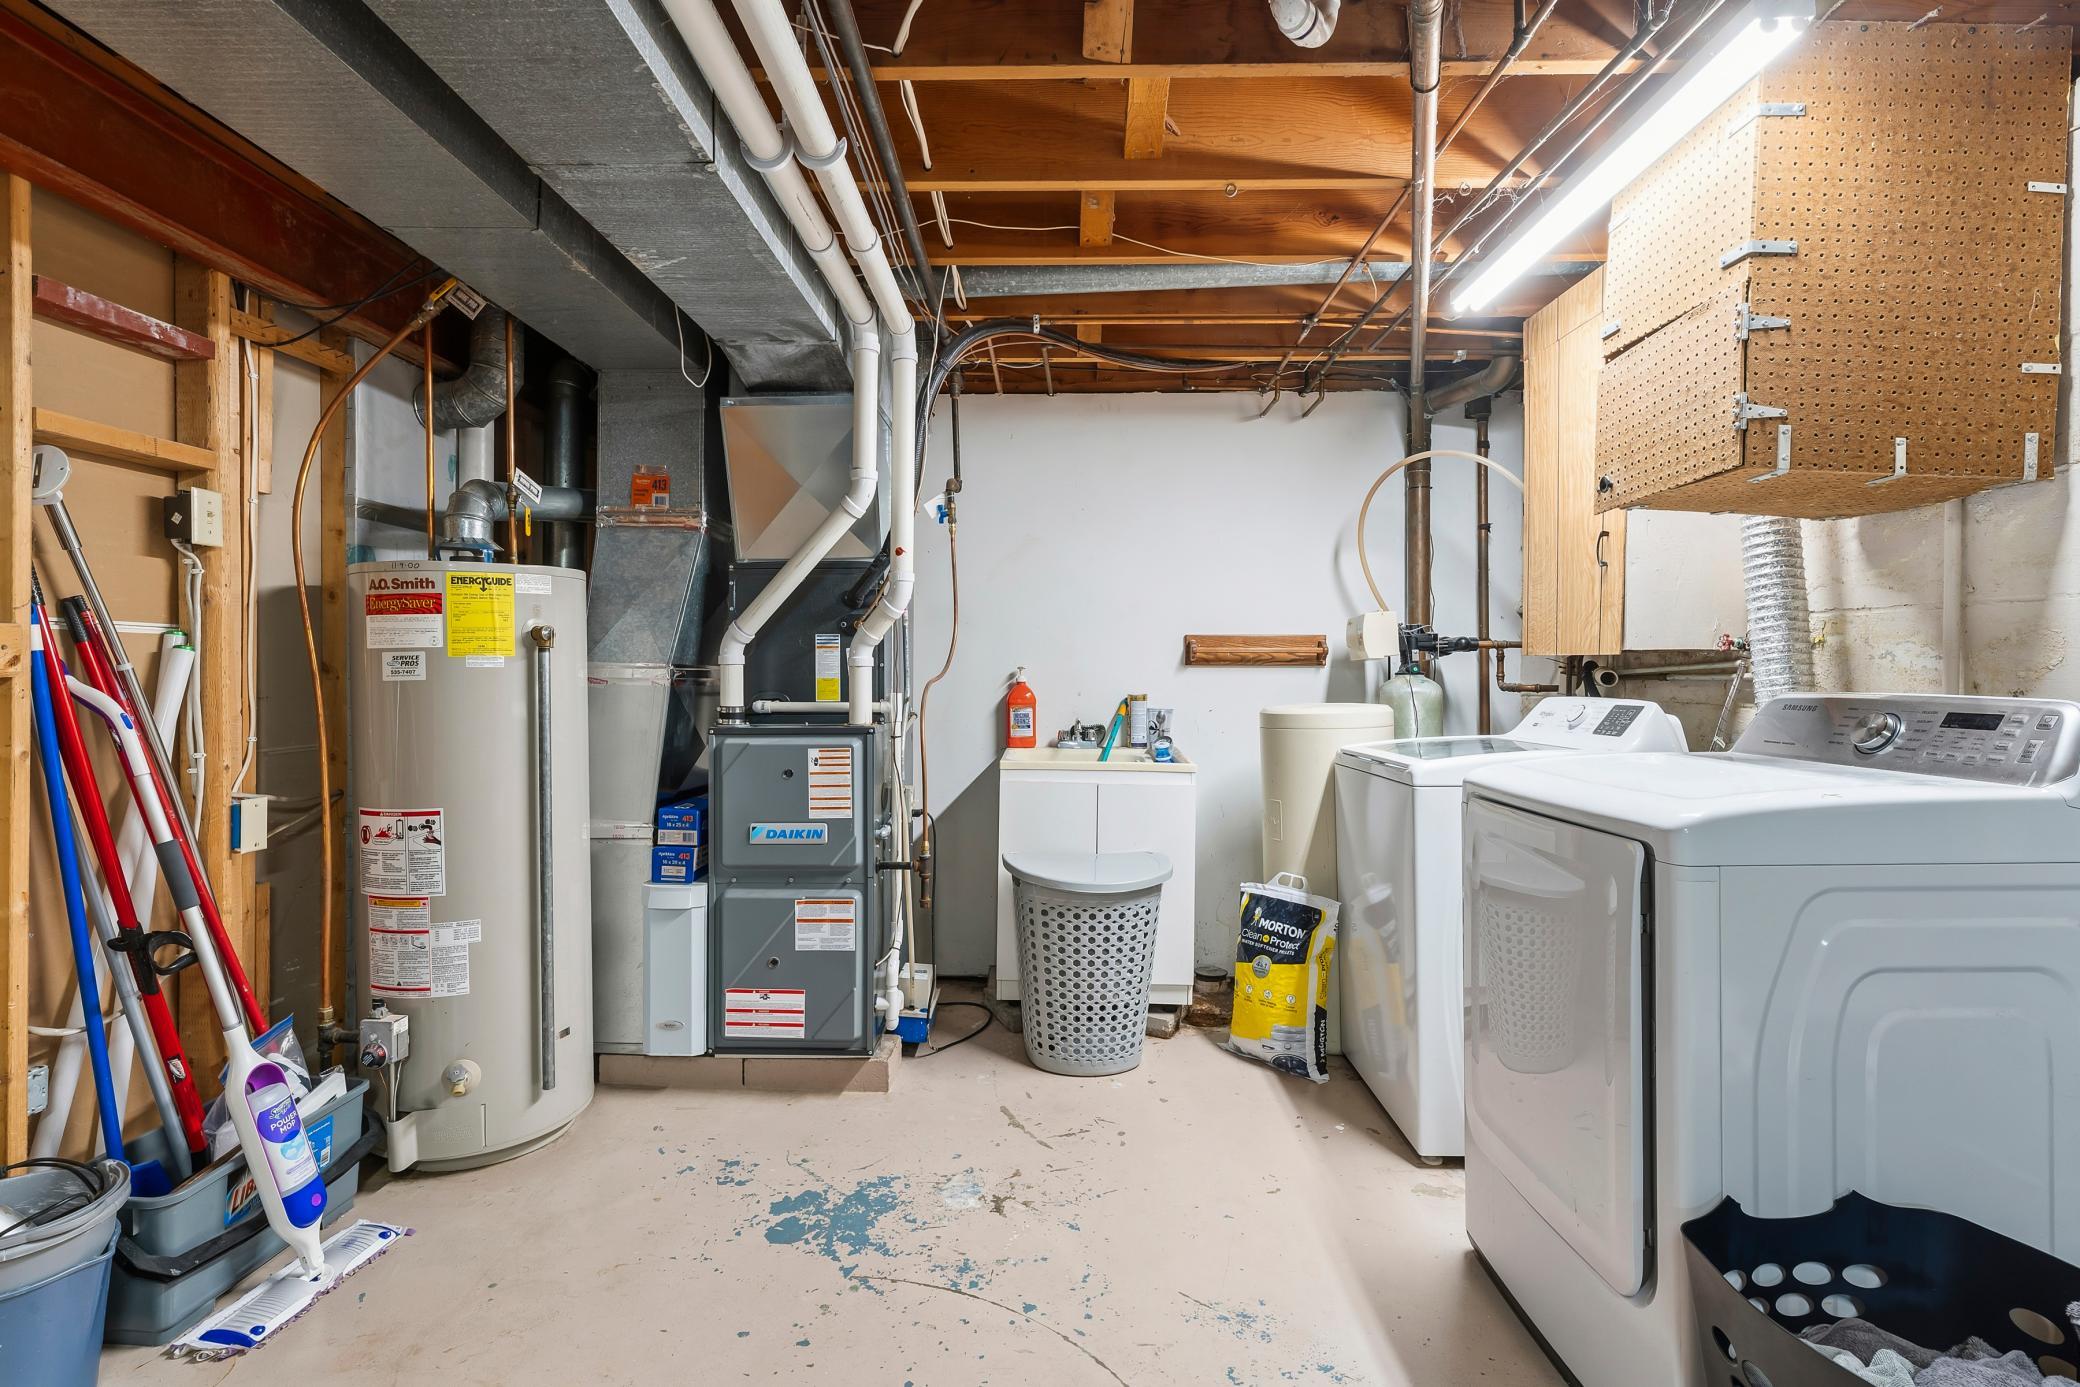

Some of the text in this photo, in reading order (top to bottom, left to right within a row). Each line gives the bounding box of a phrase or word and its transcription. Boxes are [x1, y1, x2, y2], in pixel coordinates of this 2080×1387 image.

[652, 478, 667, 491] 413
[391, 577, 436, 590] Smith
[370, 597, 436, 612] EnergySaver
[1781, 703, 1819, 712] SAMSUNG
[765, 829, 824, 839] DAIKIN
[1258, 917, 1307, 939] MORTON
[1241, 928, 1301, 950] Clean Protect
[270, 1110, 298, 1132] POWER
[280, 1119, 296, 1134] MOP
[231, 1178, 257, 1215] LIB
